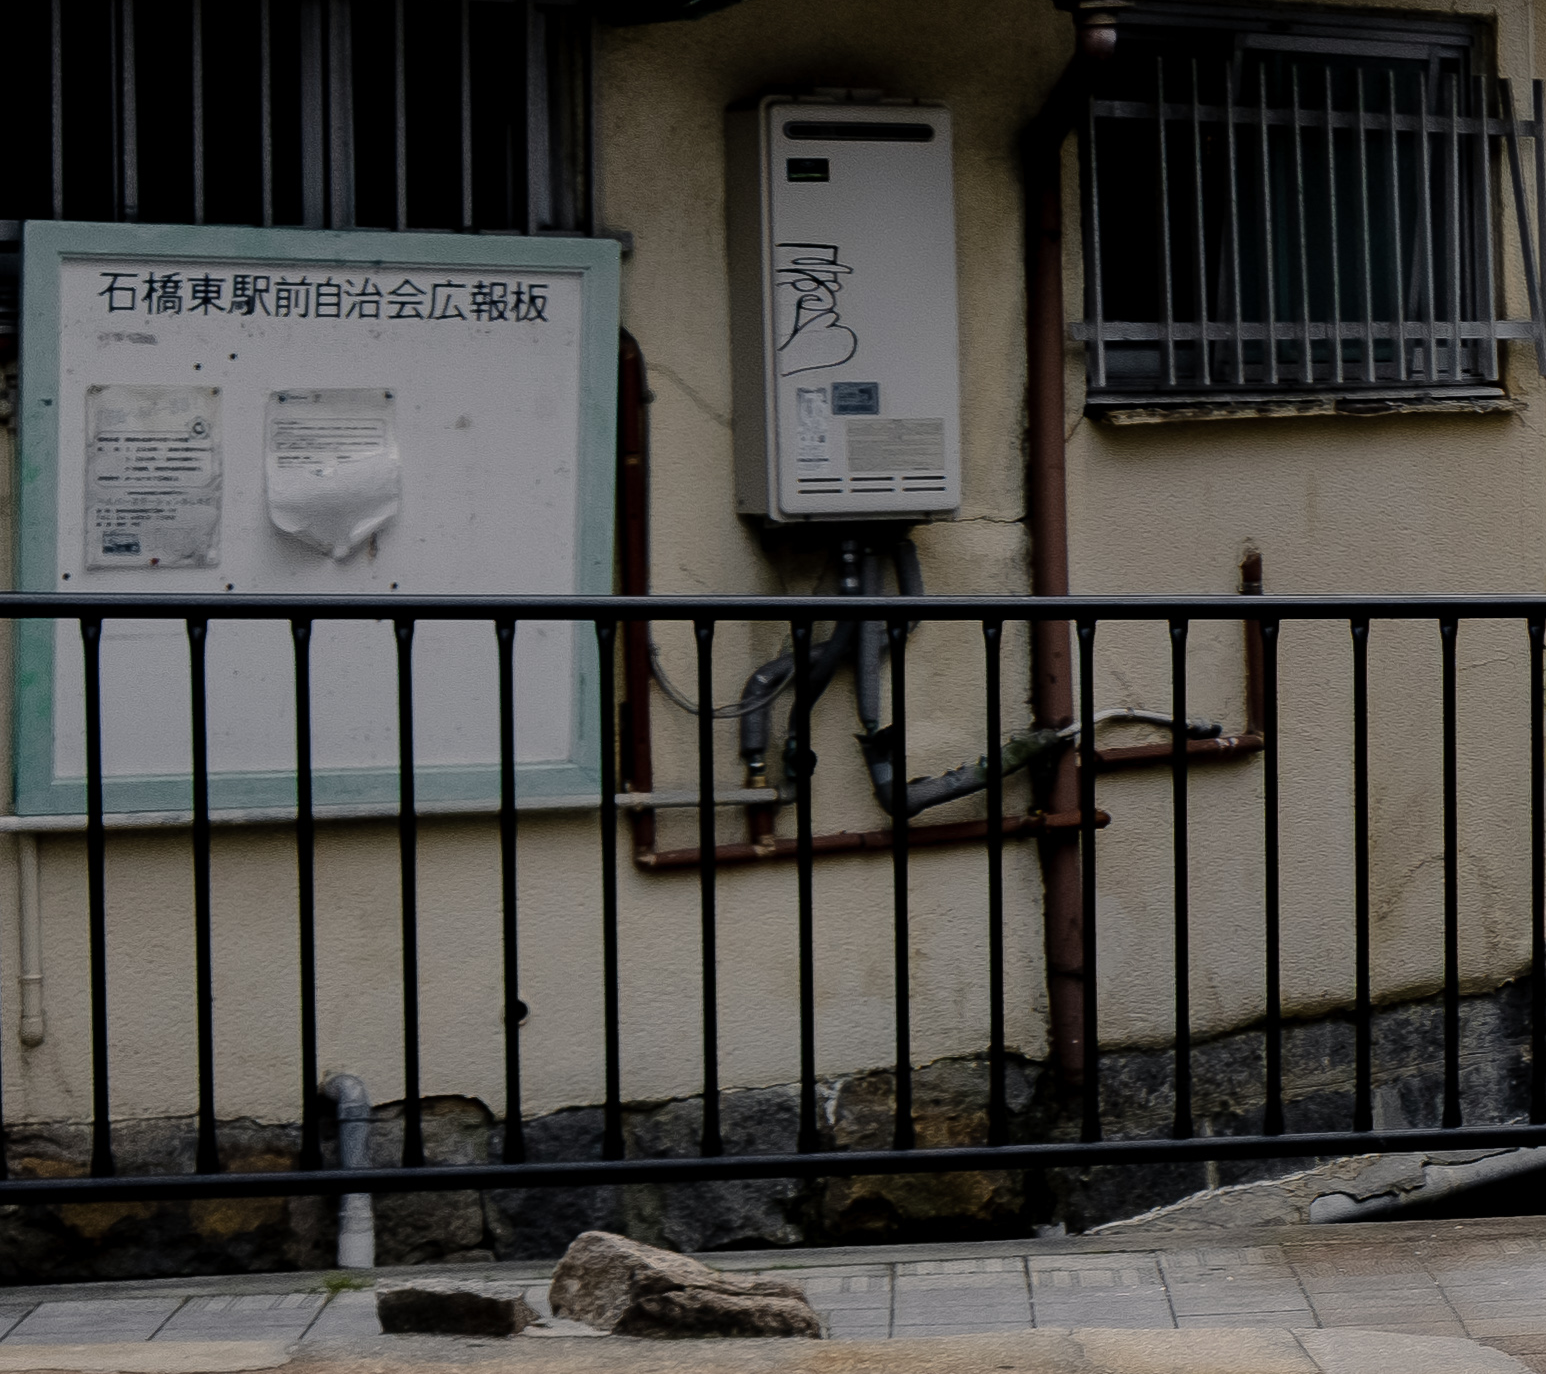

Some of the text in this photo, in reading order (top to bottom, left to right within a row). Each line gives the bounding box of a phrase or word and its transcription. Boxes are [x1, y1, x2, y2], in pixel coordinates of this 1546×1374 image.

[98, 271, 549, 323] 石橋東駅前自治会広報板
